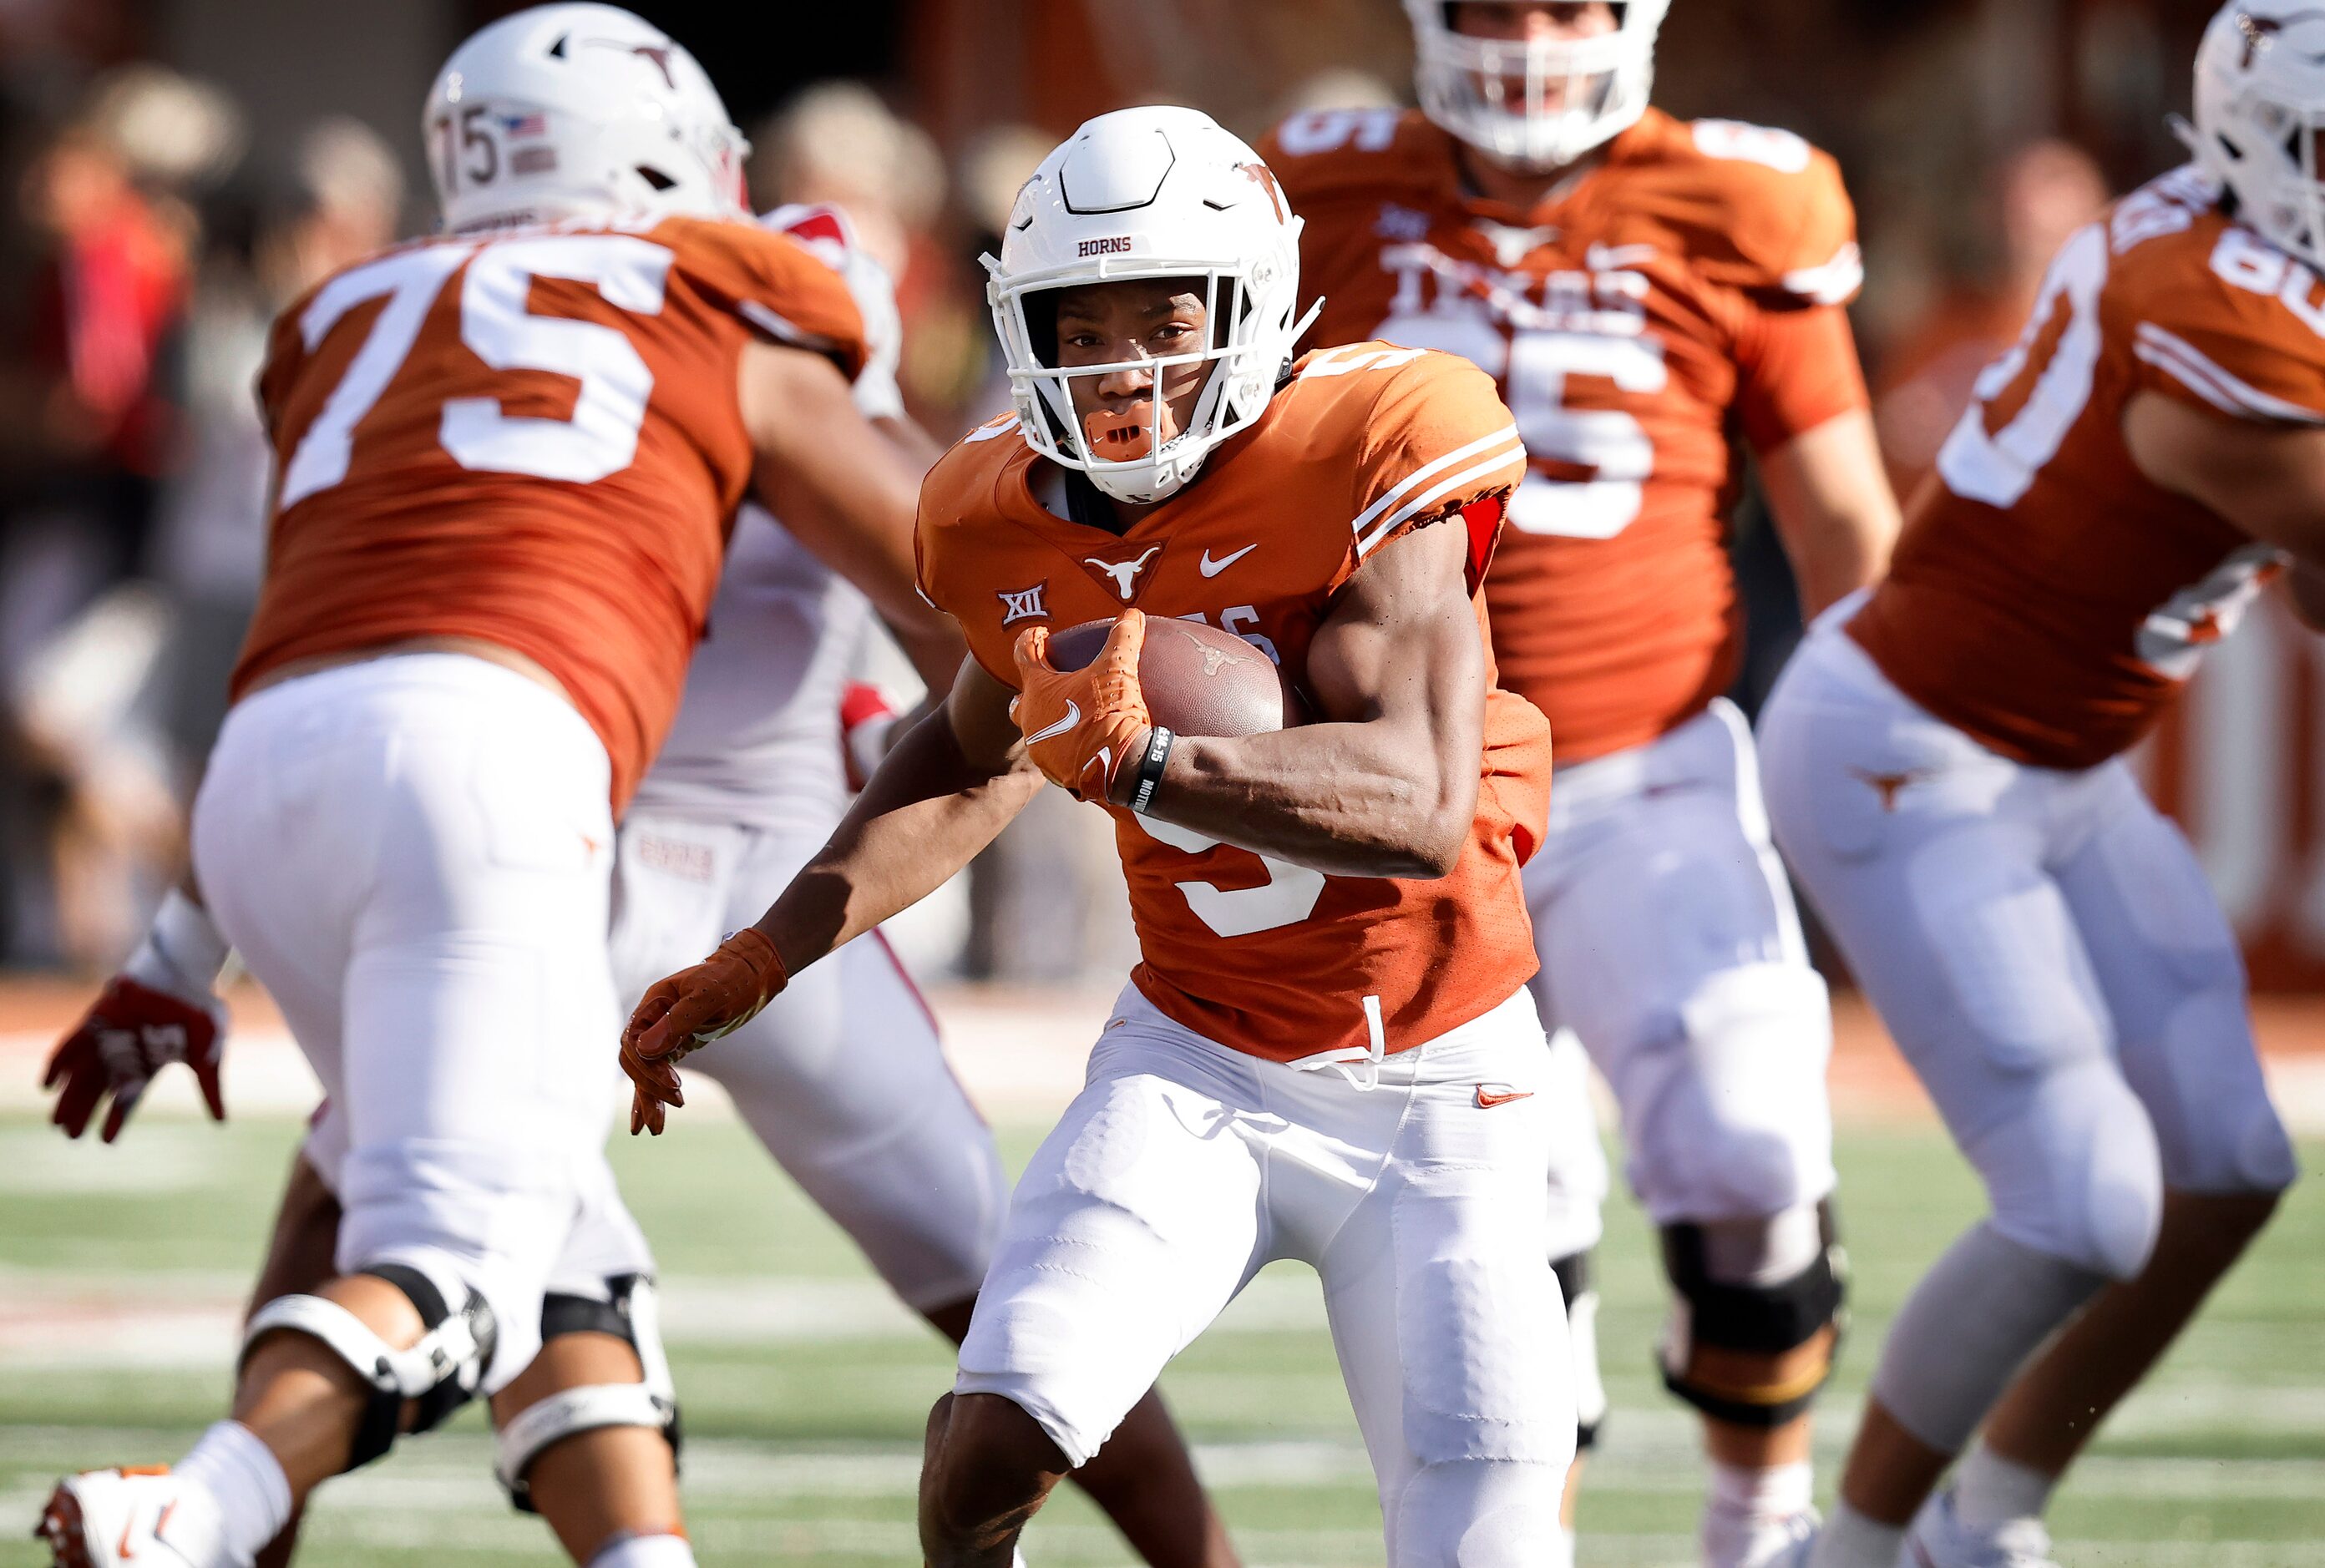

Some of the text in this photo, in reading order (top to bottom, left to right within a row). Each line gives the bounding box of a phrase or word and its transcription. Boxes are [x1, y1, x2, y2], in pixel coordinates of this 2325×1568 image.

[1078, 236, 1131, 257] HORNS
[281, 235, 674, 512] 75
[1370, 314, 1668, 540] 5
[998, 584, 1048, 625] XII
